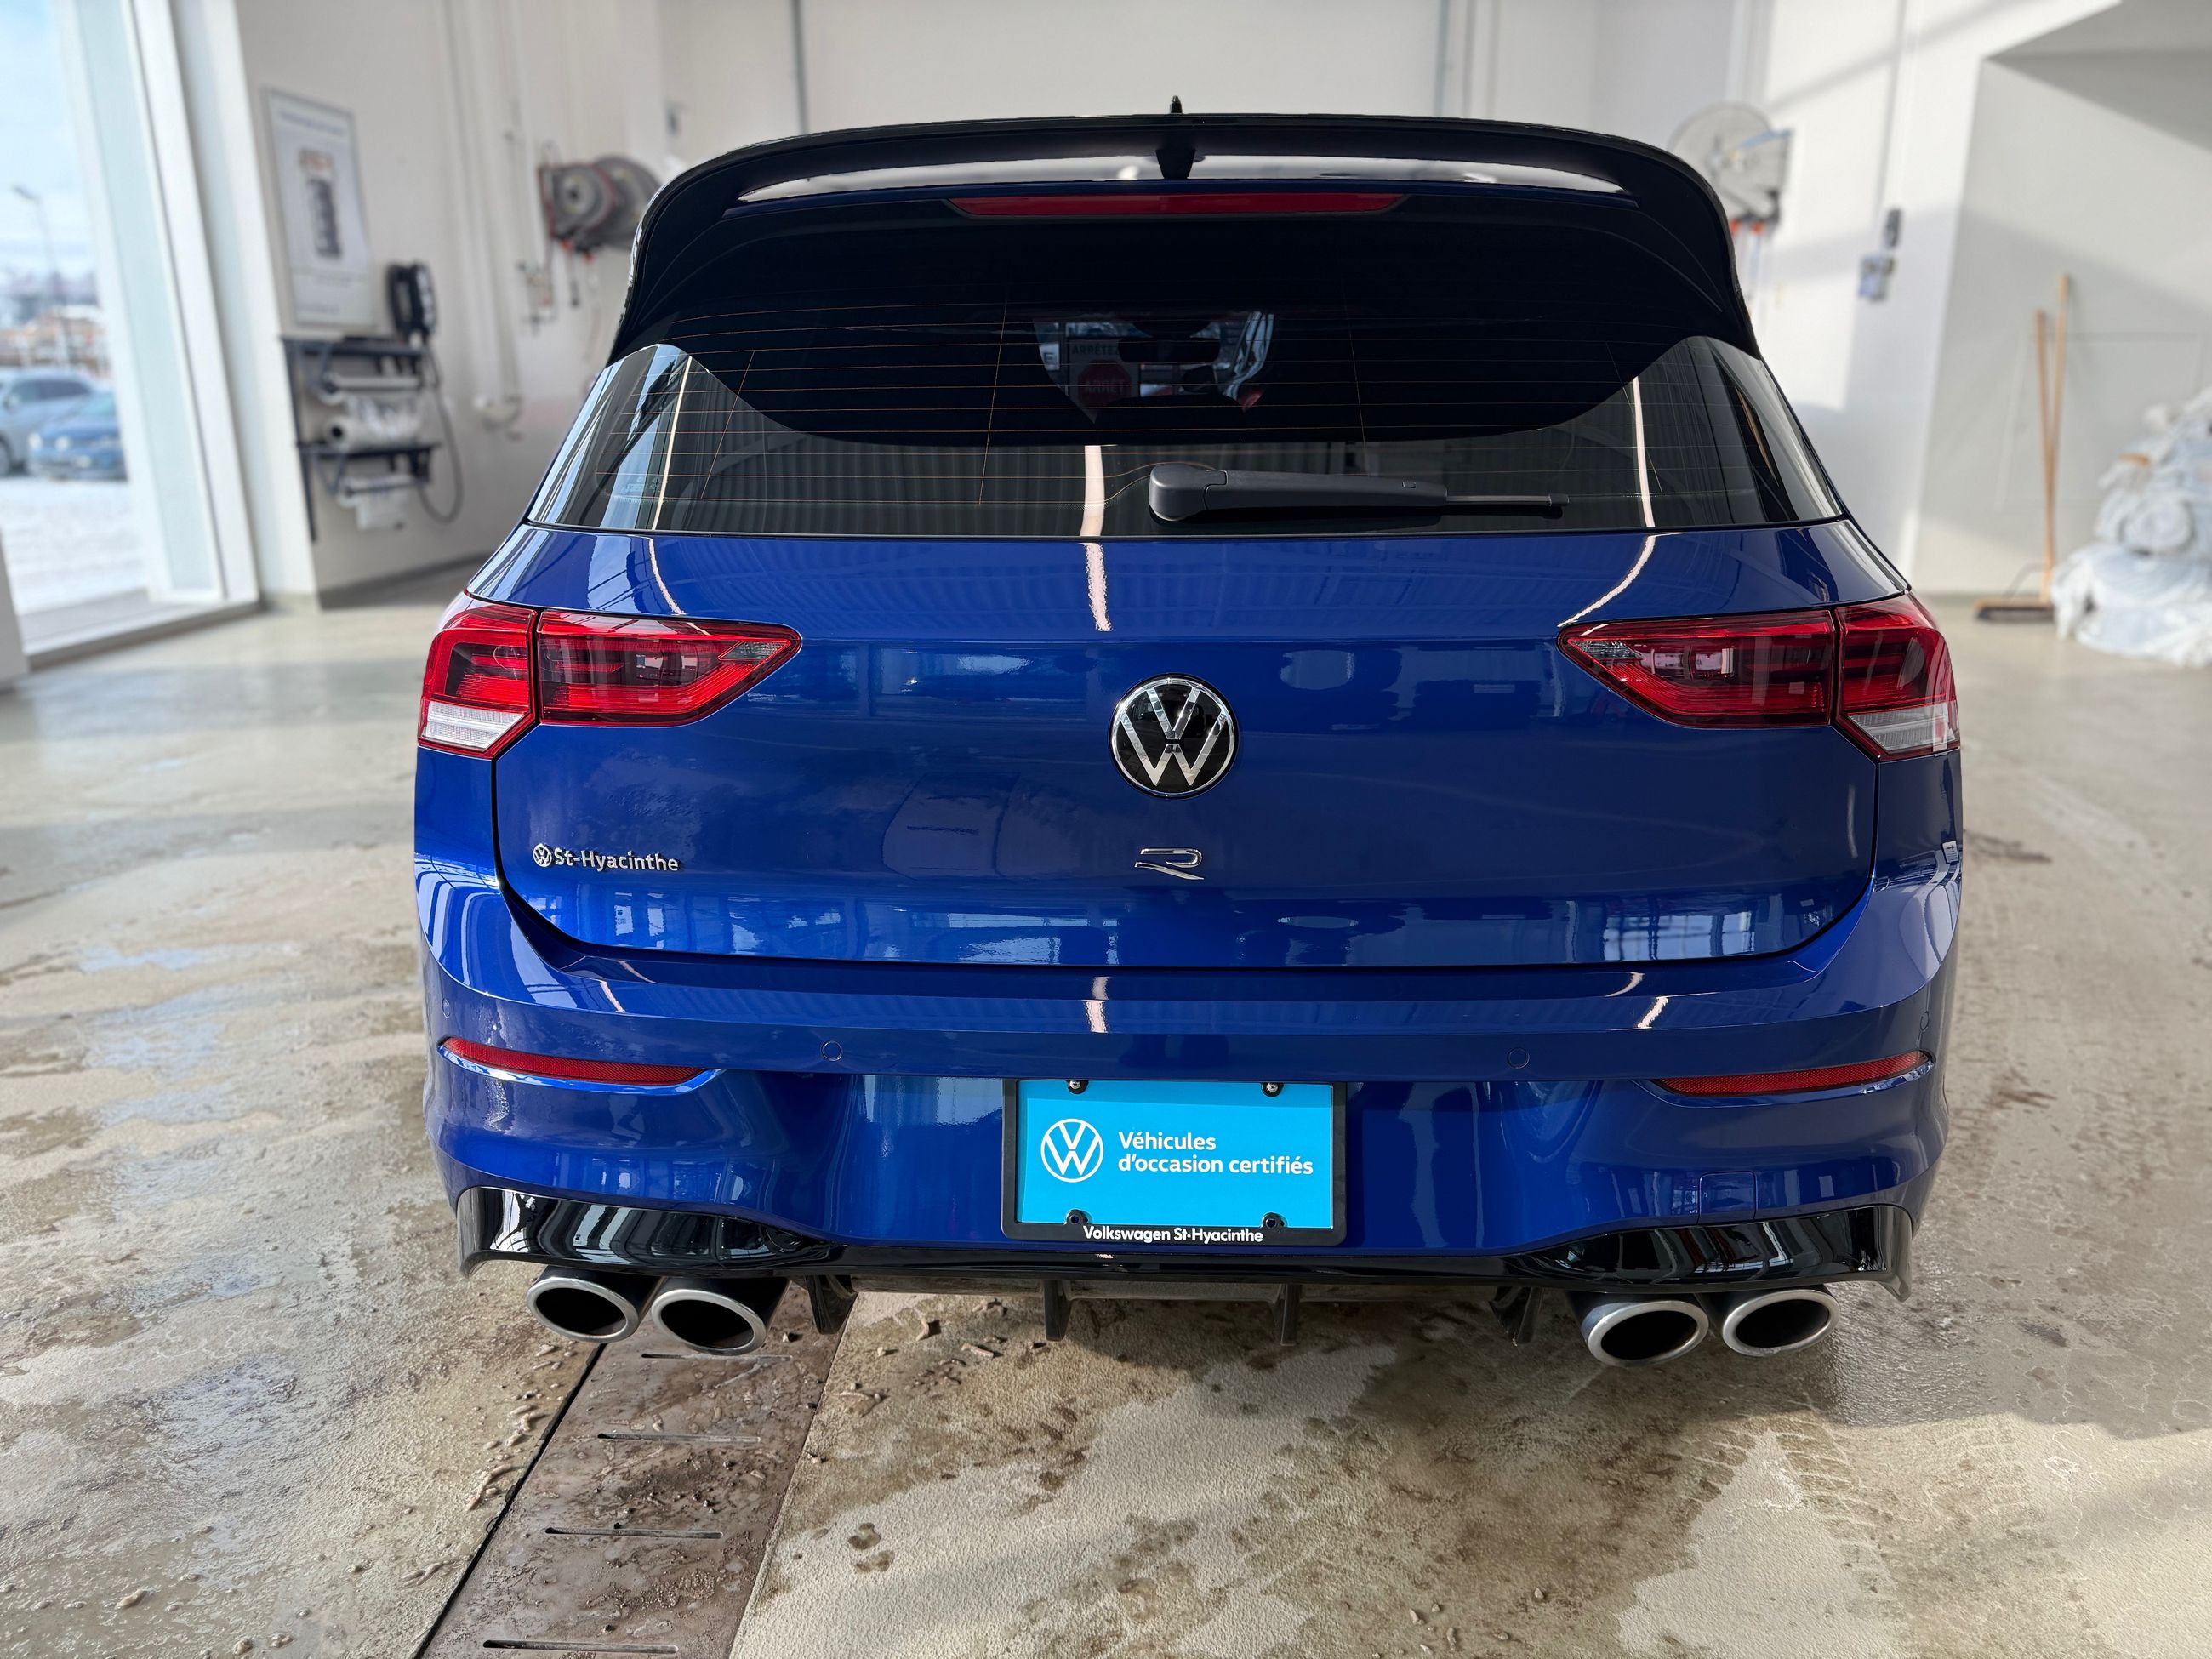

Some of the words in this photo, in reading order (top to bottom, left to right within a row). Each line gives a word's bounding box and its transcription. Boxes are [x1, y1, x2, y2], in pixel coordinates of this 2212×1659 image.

[553, 847, 680, 872] St-Hyacinthe
[1134, 847, 1205, 881] R
[1118, 1131, 1217, 1151] Véhicules
[1118, 1153, 1223, 1173] d'occasion
[1229, 1155, 1314, 1175] certifiés
[1082, 1225, 1171, 1244] Volkswagen
[1173, 1227, 1263, 1245] St-Hyacinthe
